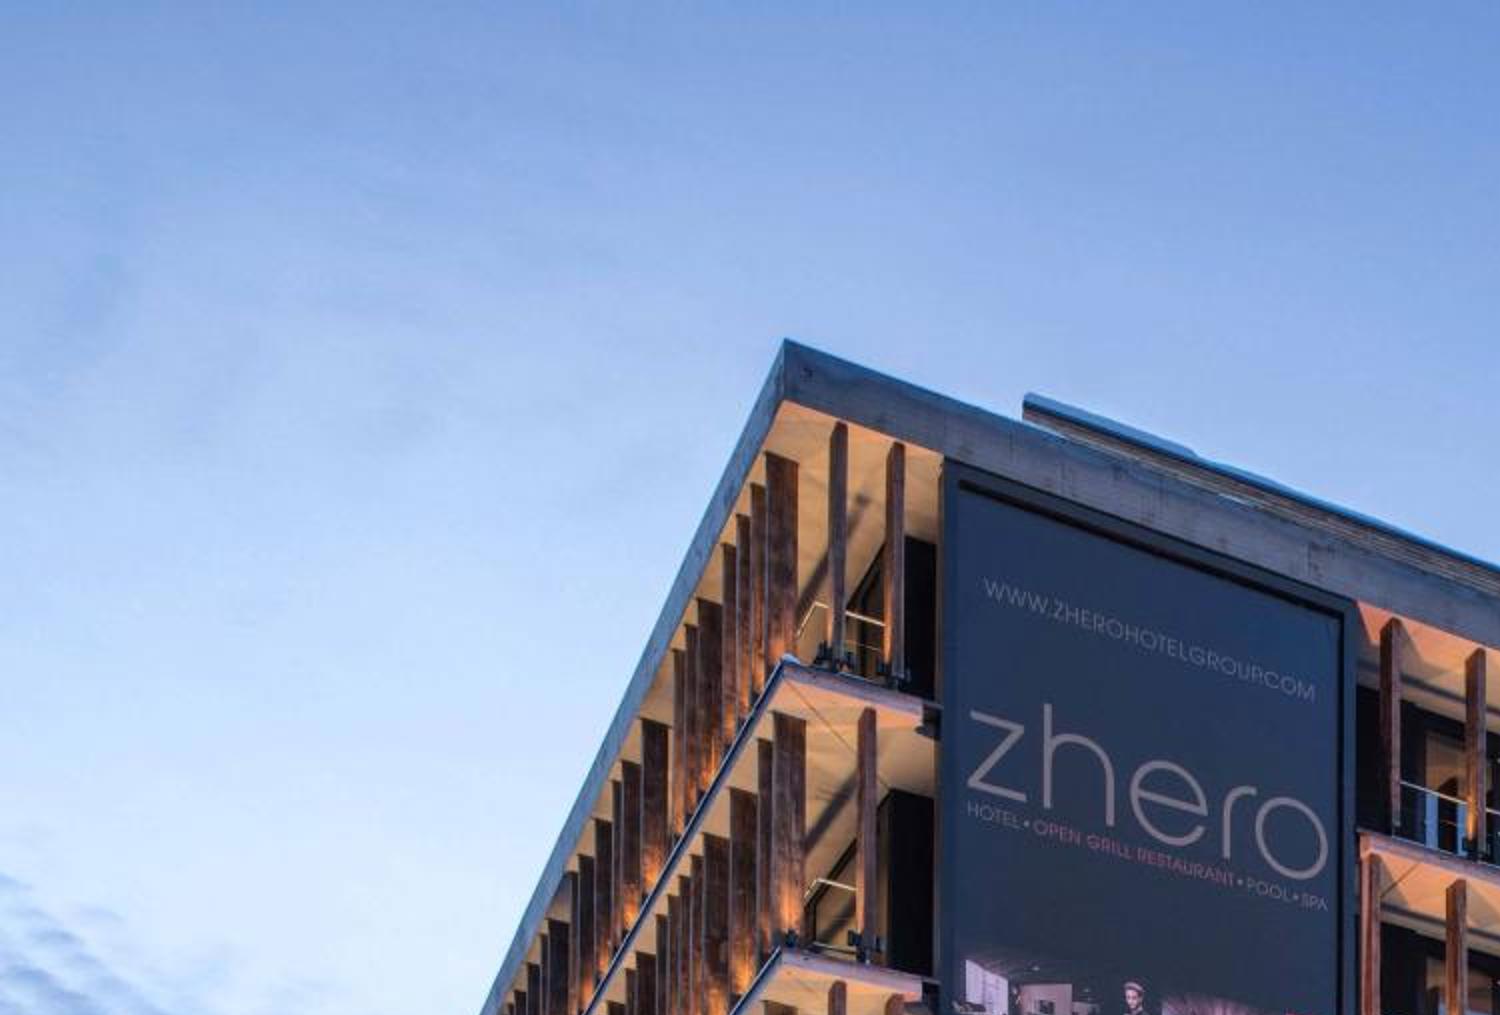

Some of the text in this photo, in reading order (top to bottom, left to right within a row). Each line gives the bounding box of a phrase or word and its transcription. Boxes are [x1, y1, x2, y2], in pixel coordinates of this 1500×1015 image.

[967, 703, 1330, 881] zhero
[967, 800, 1329, 912] HOTEL OPEN GRILL RESTAURANT POOL SPA
